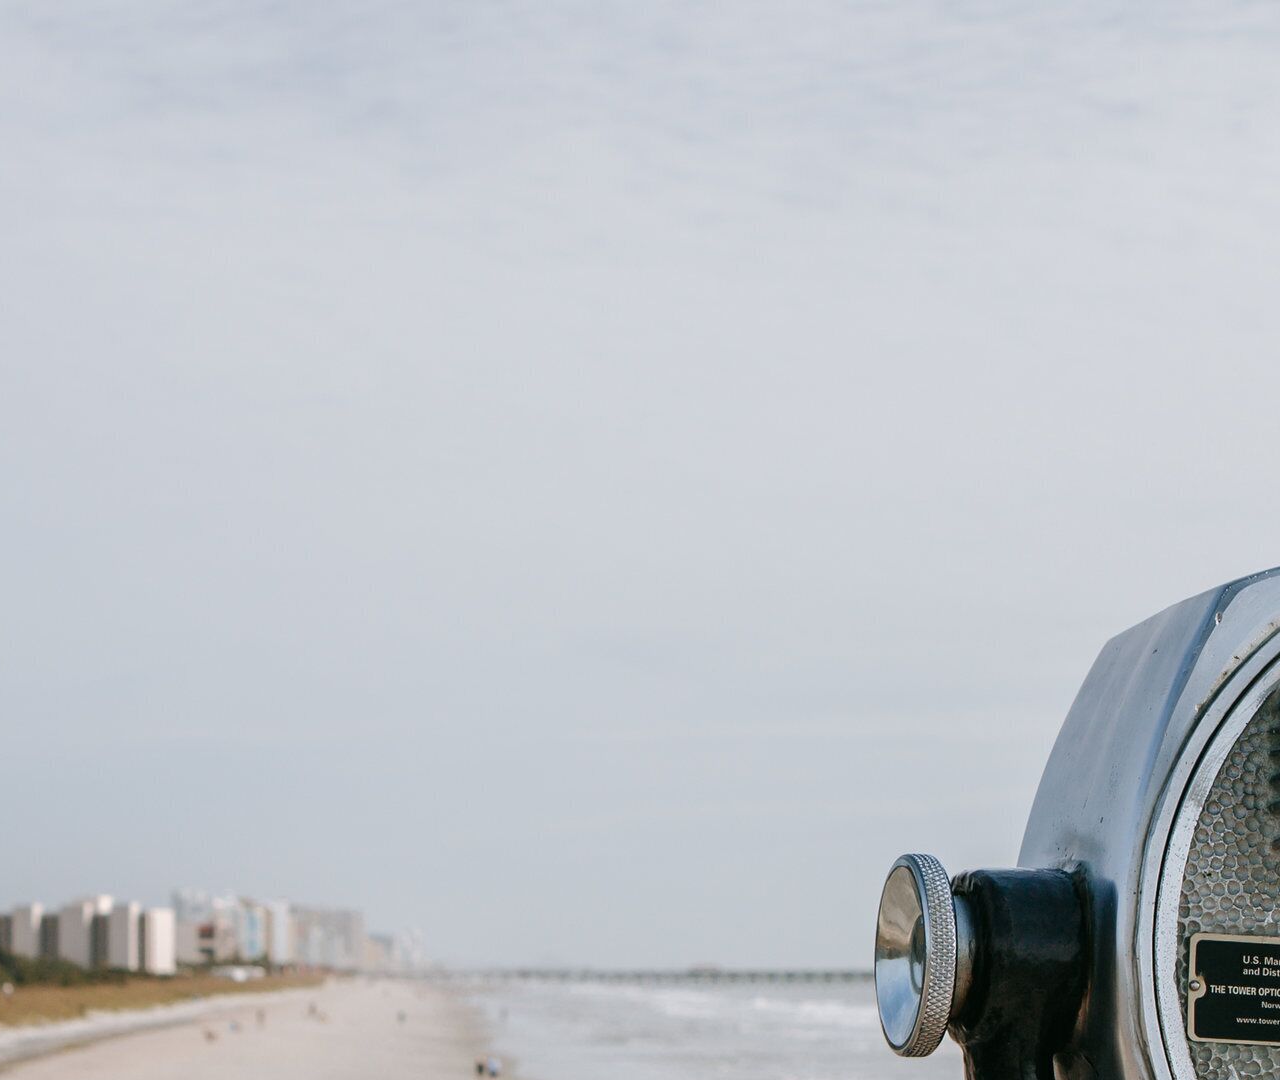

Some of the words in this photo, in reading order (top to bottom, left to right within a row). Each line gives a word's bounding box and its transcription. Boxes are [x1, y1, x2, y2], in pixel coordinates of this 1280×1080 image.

[1242, 955, 1262, 965] U.S.
[1242, 967, 1260, 976] and
[1210, 984, 1226, 994] THE
[1228, 985, 1257, 996] TOWER
